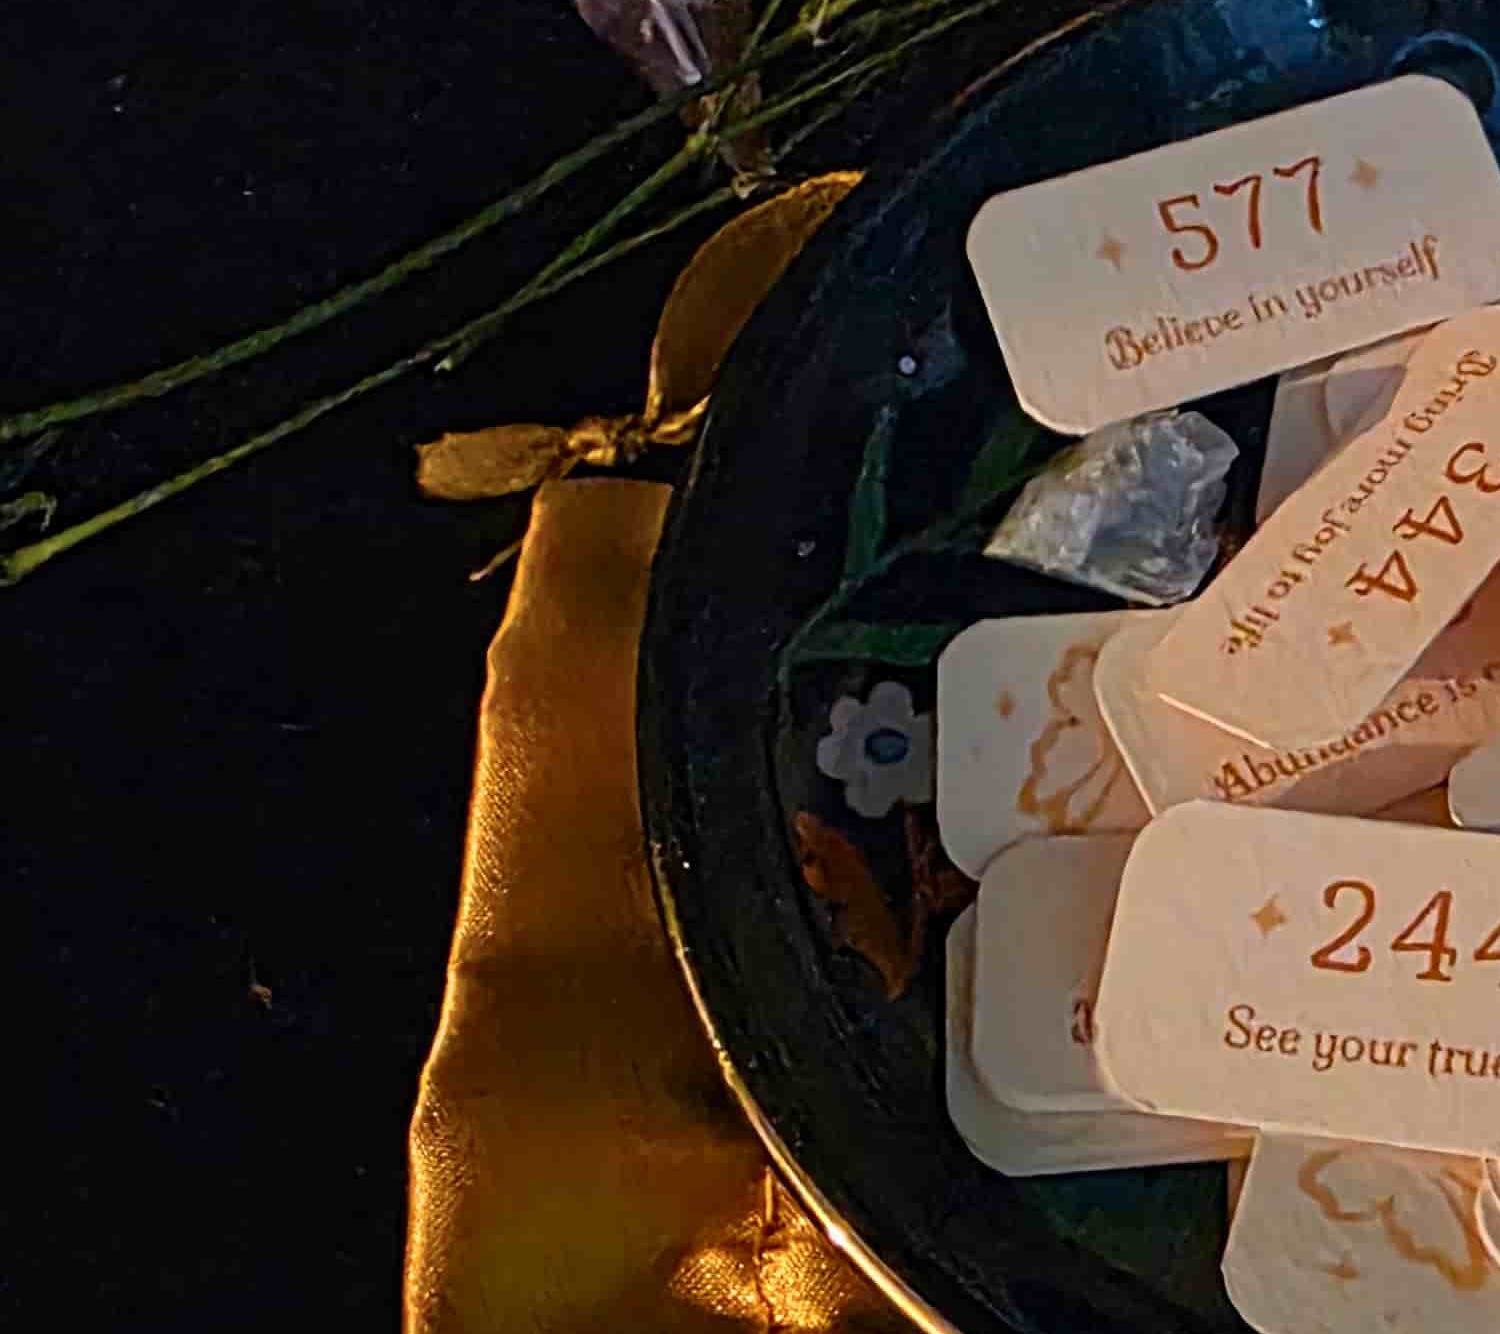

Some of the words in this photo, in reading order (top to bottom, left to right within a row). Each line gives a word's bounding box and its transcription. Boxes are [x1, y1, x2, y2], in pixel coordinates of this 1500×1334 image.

[1158, 155, 1324, 271] 577
[1104, 306, 1241, 371] Believe
[1251, 291, 1288, 325] in
[1295, 234, 1440, 318] yourself
[1404, 349, 1498, 436] Bring
[1340, 436, 1411, 515] more
[1267, 568, 1304, 602] to
[1222, 605, 1281, 656] life
[1224, 1002, 1301, 1056] See
[1311, 1025, 1418, 1072] your
